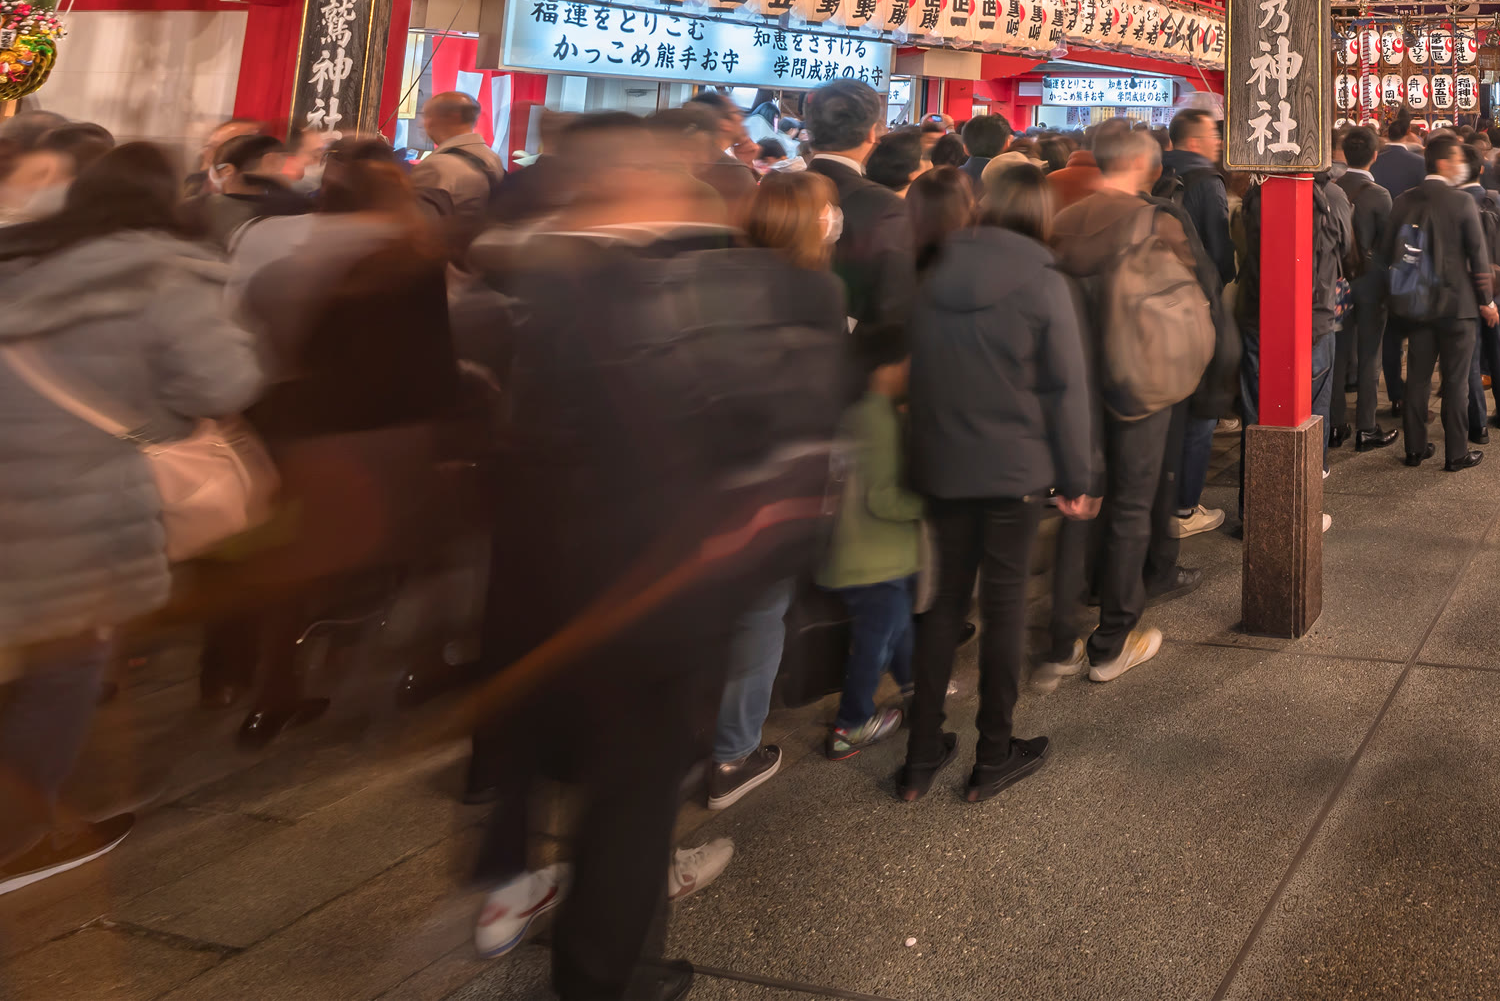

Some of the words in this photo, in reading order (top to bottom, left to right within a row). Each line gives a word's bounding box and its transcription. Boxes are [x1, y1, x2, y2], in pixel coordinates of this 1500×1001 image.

[552, 33, 740, 75] かっこめ熊手お守
[1107, 78, 1159, 90] 知恵をずける
